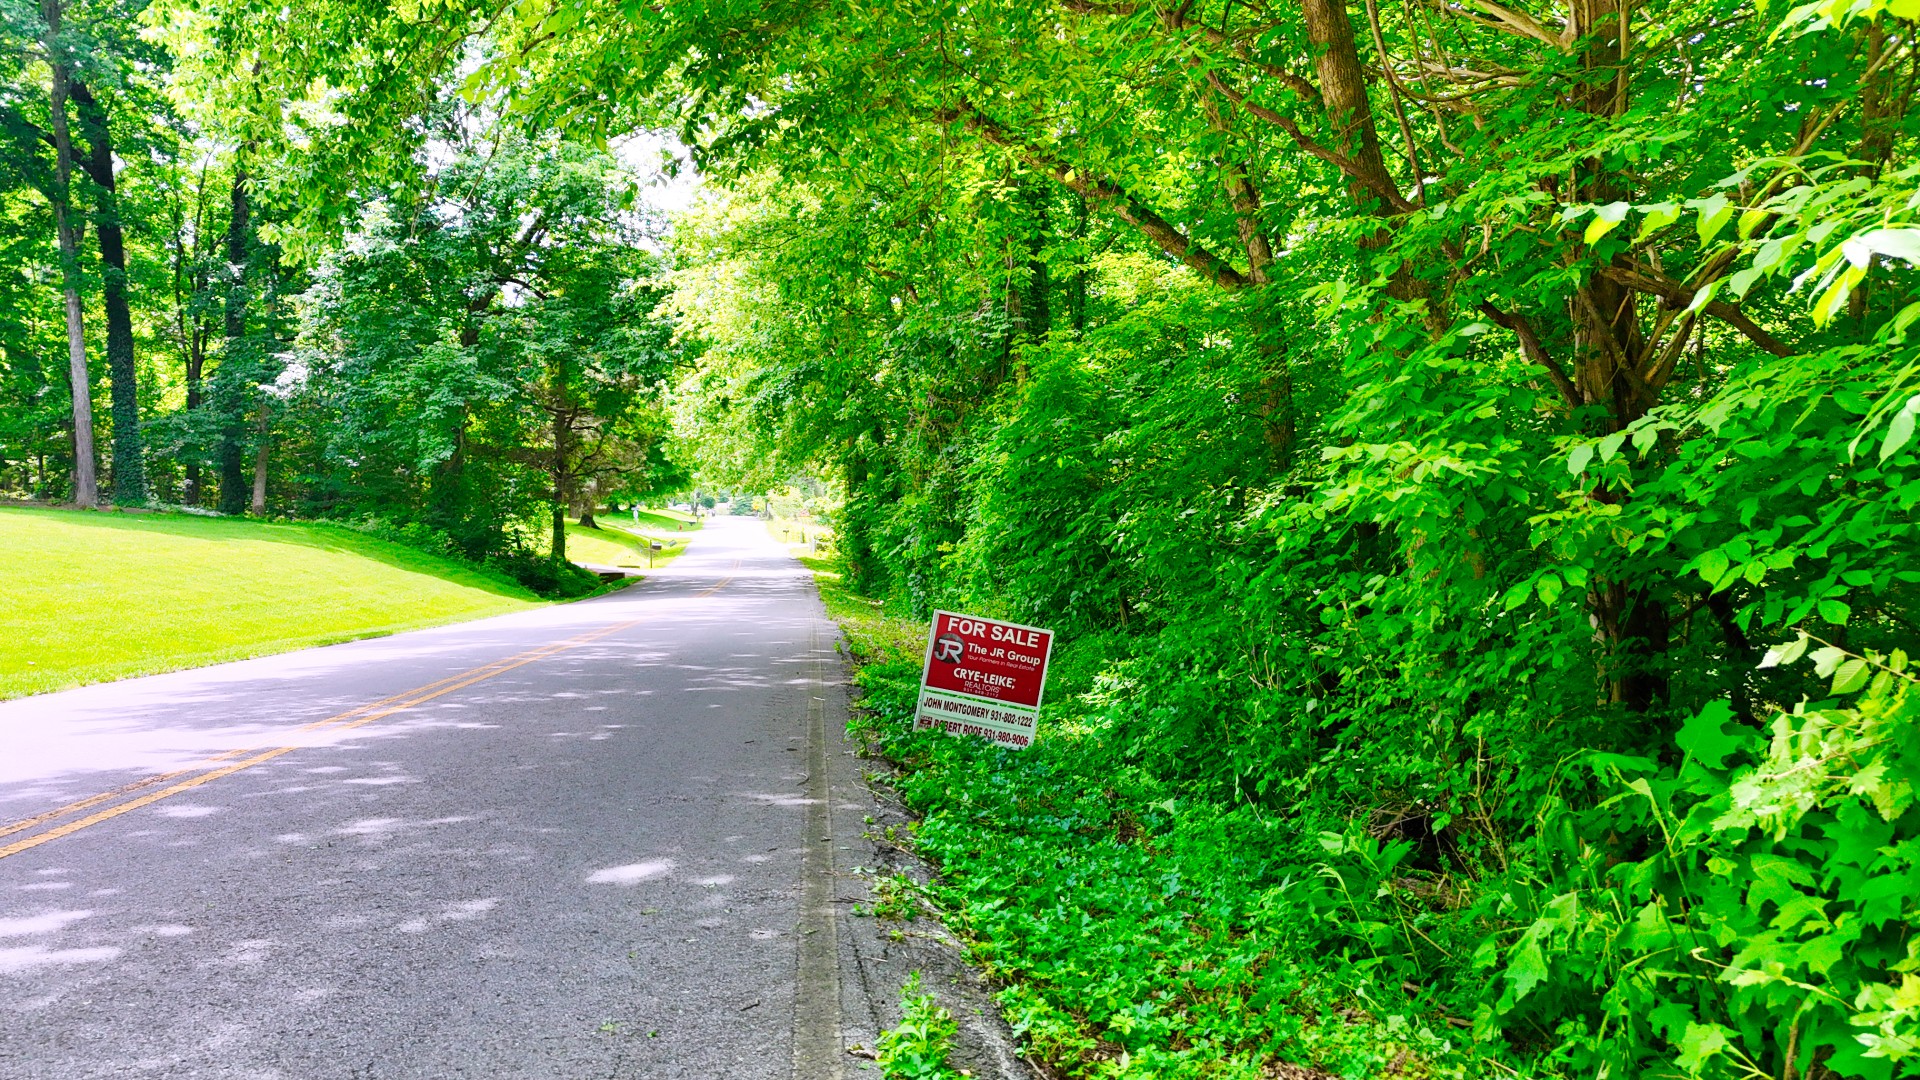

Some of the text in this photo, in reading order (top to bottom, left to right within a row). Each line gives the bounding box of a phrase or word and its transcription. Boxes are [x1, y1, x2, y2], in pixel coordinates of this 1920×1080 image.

[947, 617, 1040, 648] FOR SALE
[934, 638, 964, 664] JR
[968, 643, 1041, 666] The JR Group
[979, 657, 1000, 665] Partners
[1018, 663, 1035, 672] Estate
[924, 697, 1033, 728] JOHN MONTGOMERY 931-802-1222
[962, 724, 982, 737] ROOF
[984, 727, 1029, 746] 931-980-9006
